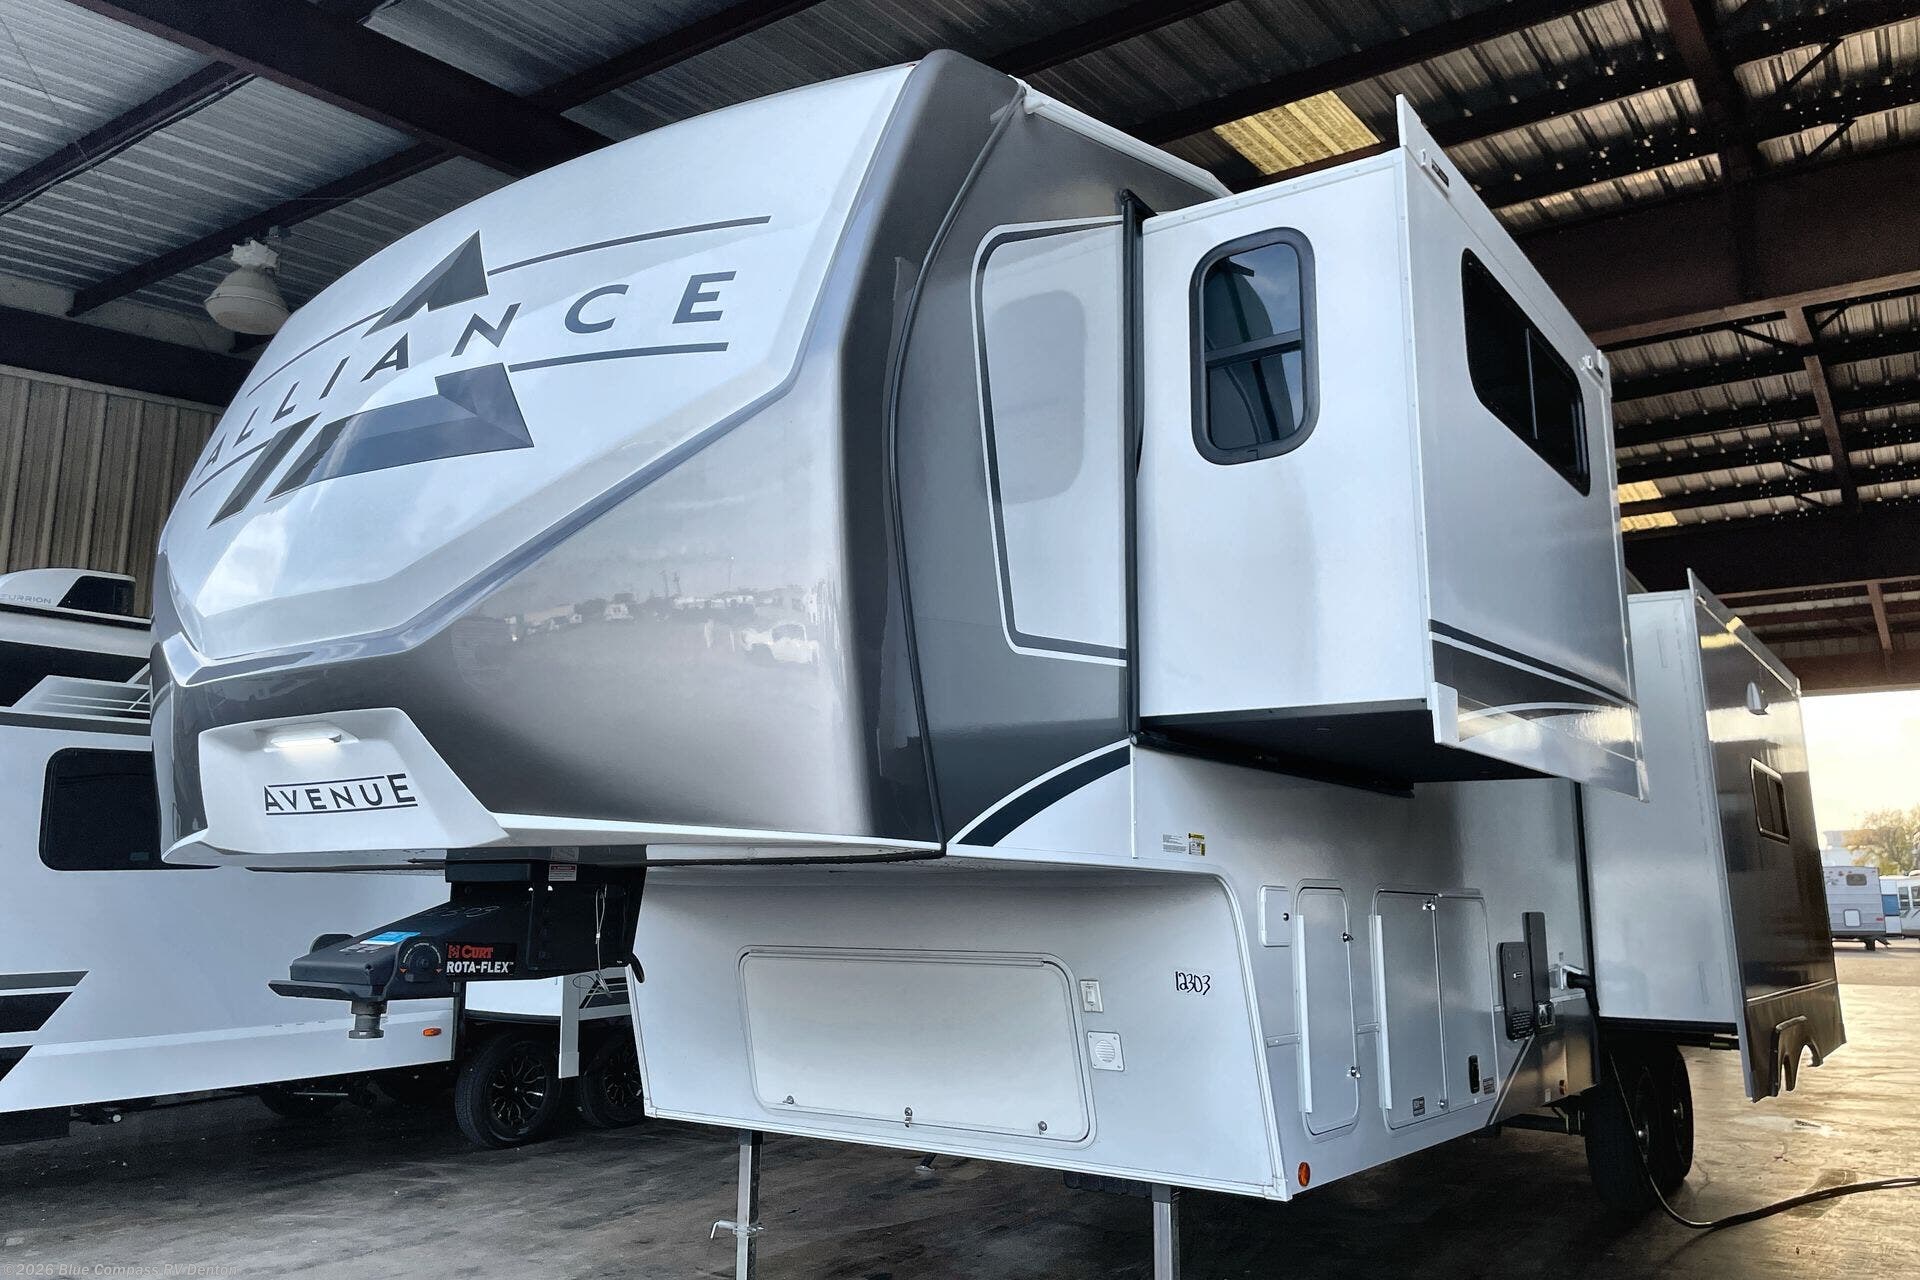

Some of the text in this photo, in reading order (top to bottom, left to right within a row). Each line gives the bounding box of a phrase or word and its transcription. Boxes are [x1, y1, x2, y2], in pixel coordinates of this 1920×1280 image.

[196, 270, 736, 481] ALLIANCE
[263, 773, 417, 812] AVENUE
[461, 945, 494, 959] CURT
[1175, 971, 1211, 996] 12303
